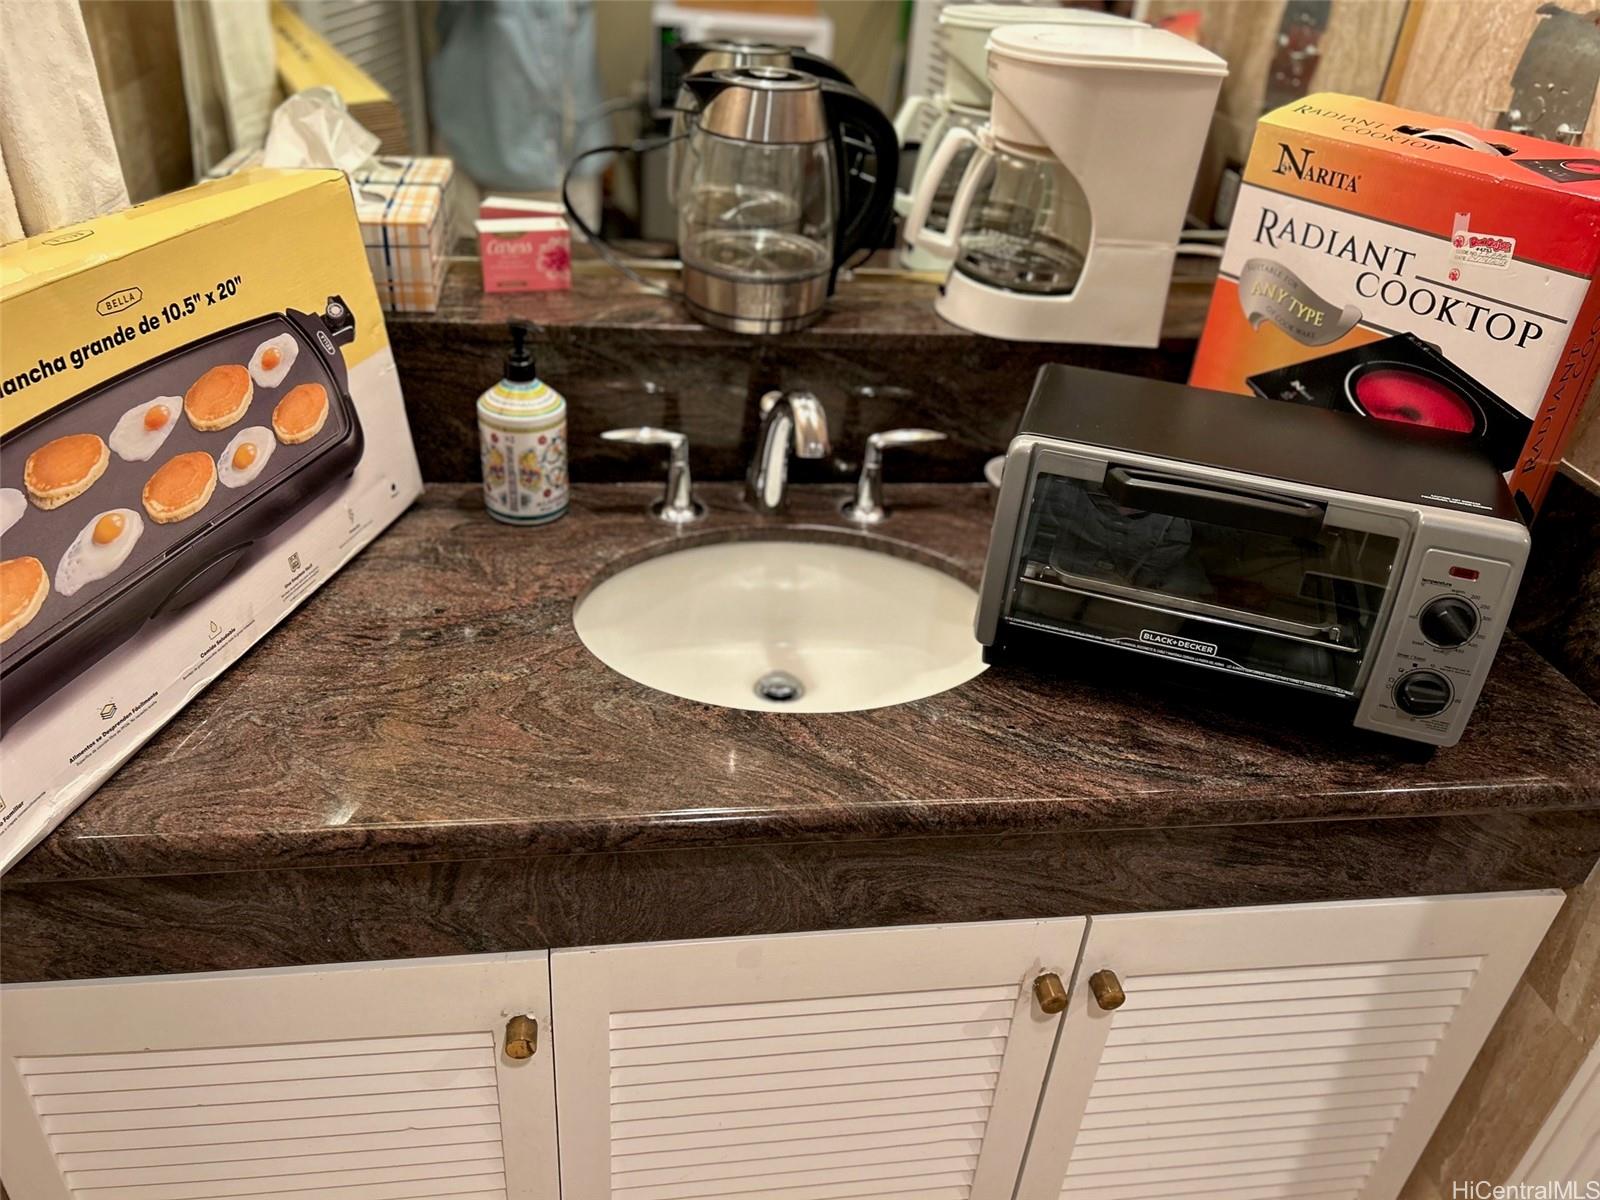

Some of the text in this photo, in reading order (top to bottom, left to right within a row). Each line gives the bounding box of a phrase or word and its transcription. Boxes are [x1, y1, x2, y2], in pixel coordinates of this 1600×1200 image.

[1293, 104, 1387, 129] RADIANT
[1342, 124, 1441, 152] COOKTOP
[1272, 142, 1358, 193] NARITA
[1253, 206, 1417, 278] RADIANT
[70, 325, 136, 370] grande
[138, 315, 161, 335] de
[161, 293, 201, 324] 10.5"
[204, 291, 216, 306] x
[216, 275, 242, 300] 20"
[105, 292, 136, 311] BELLA
[1250, 281, 1326, 327] ANY TYPE
[1356, 271, 1544, 349] COOKTOP
[1521, 343, 1581, 474] RADIANT
[1142, 631, 1215, 655] BLACK+DECKER
[69, 740, 96, 764] Alimentos
[101, 711, 133, 738] Desprenden
[3, 800, 24, 823] Familiar
